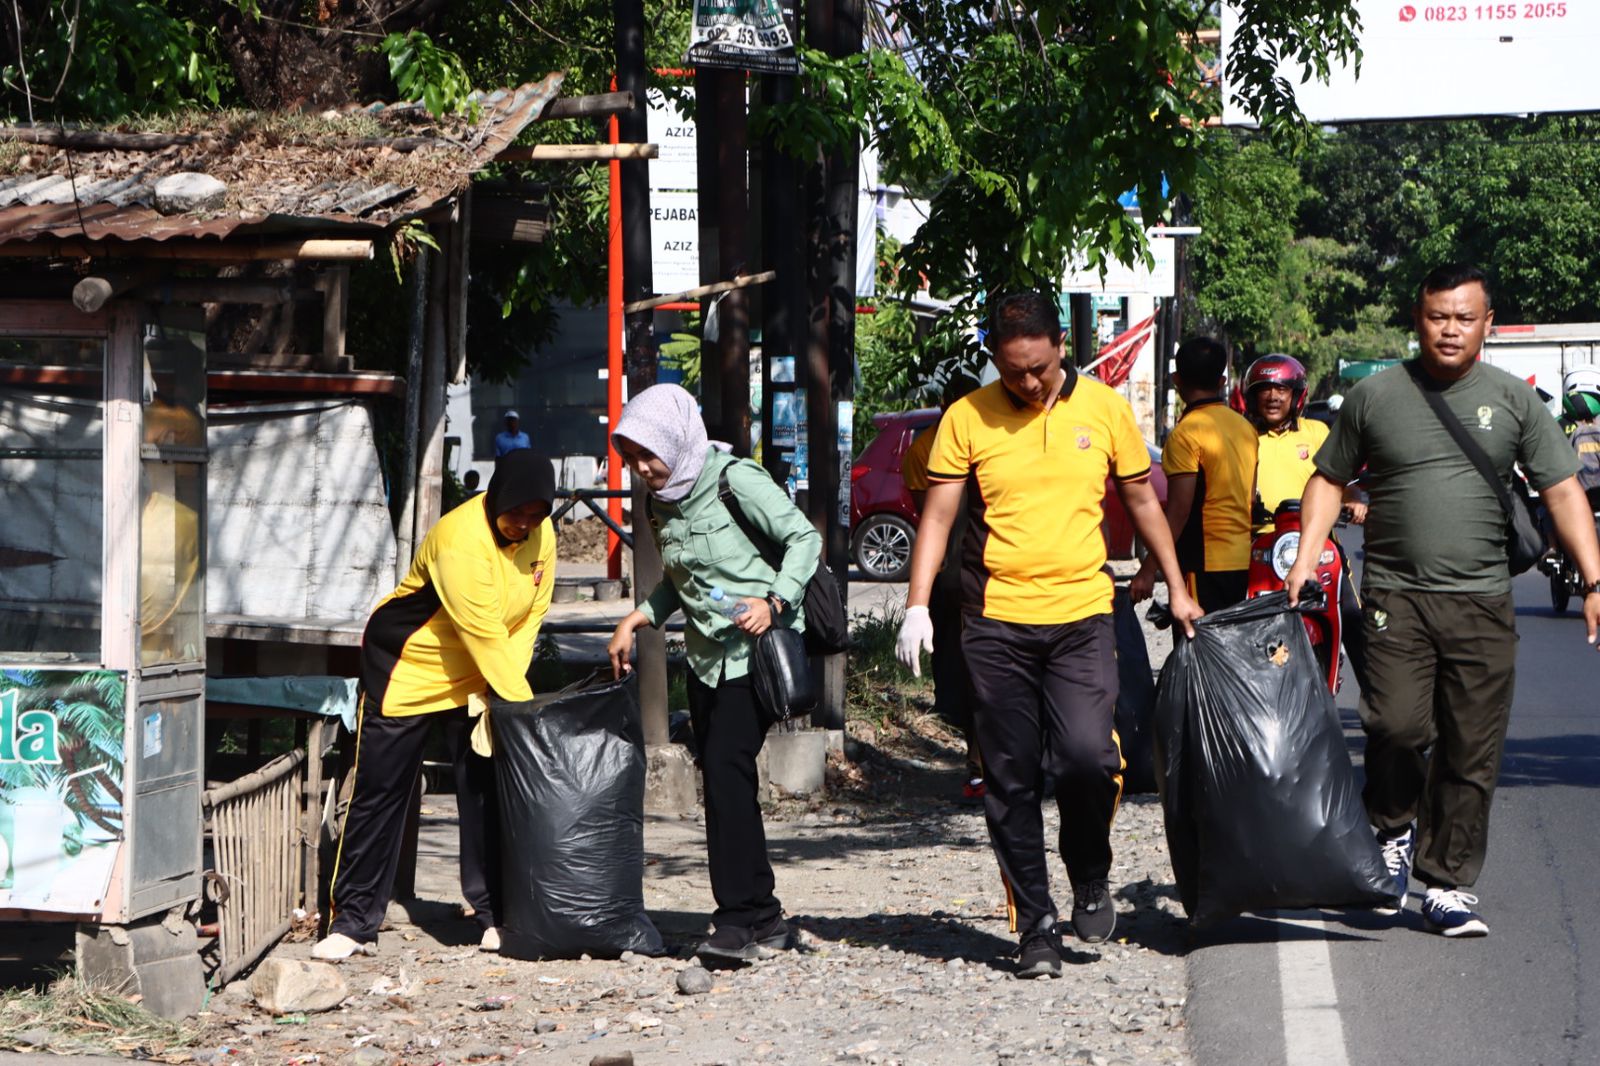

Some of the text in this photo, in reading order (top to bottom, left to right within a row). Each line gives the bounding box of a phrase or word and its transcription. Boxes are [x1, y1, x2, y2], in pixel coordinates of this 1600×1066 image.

[1424, 3, 1567, 21] 0823 1155 2055
[665, 127, 694, 138] AZIZ
[664, 241, 693, 251] AZIZ
